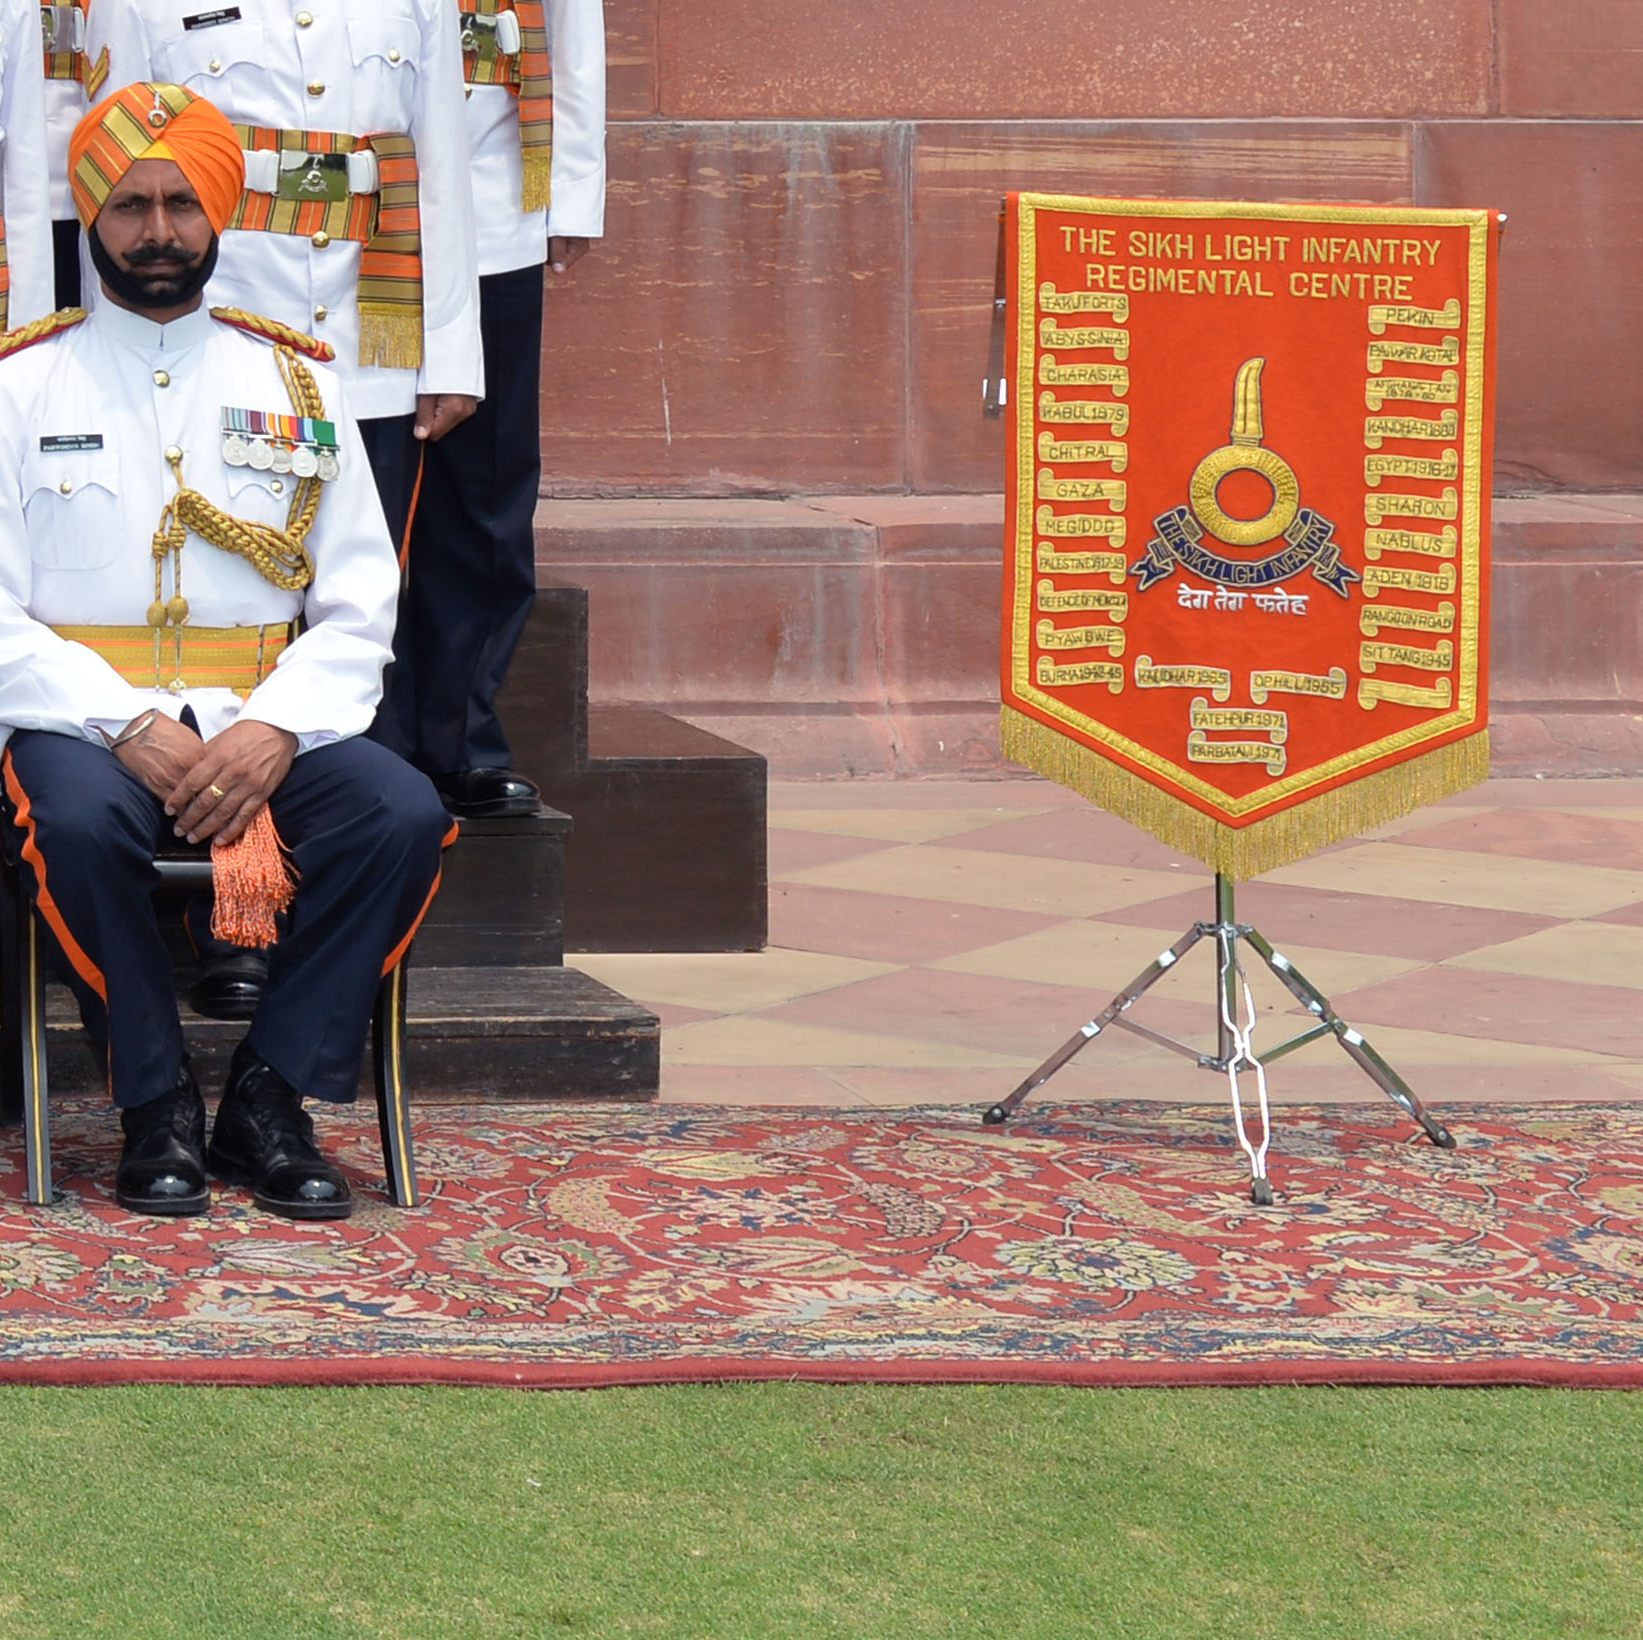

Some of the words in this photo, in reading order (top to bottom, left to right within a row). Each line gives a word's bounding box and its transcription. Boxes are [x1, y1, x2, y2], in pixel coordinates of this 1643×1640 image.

[1059, 226, 1117, 256] THE
[1129, 231, 1193, 260] SIKH
[1205, 234, 1290, 262] LIGHT
[1303, 237, 1441, 266] INFANTRY
[1086, 263, 1274, 296] REGIMENTAL
[1290, 272, 1414, 301] CENTRE
[1083, 297, 1126, 310] FORTS
[1386, 307, 1435, 325] PEKIN
[1044, 332, 1124, 346] ABYSSINIA
[1047, 368, 1122, 382] CHARASIA
[1042, 406, 1090, 419] KABUL
[1092, 408, 1125, 421] 1879
[1049, 445, 1115, 460] CHITRAL
[1367, 459, 1410, 472] EGYPT
[1056, 483, 1104, 497] GAZA
[1375, 497, 1445, 515] SHARON
[1046, 519, 1115, 534] MEGIDDO
[1160, 516, 1185, 550] THE
[1178, 543, 1217, 576] SIKH
[1221, 564, 1266, 583] LIGHT
[1273, 518, 1328, 577] INFANTRY
[1376, 534, 1443, 552] NABLUS
[1370, 571, 1411, 584] ADEN
[1177, 583, 1213, 610] देग
[1214, 584, 1248, 610] तेग
[1251, 587, 1309, 615] फतेह
[1419, 615, 1451, 628] ROAD
[1421, 652, 1450, 667] 1945
[1193, 712, 1255, 725] FATEHPUR
[1257, 714, 1285, 727] 1971
